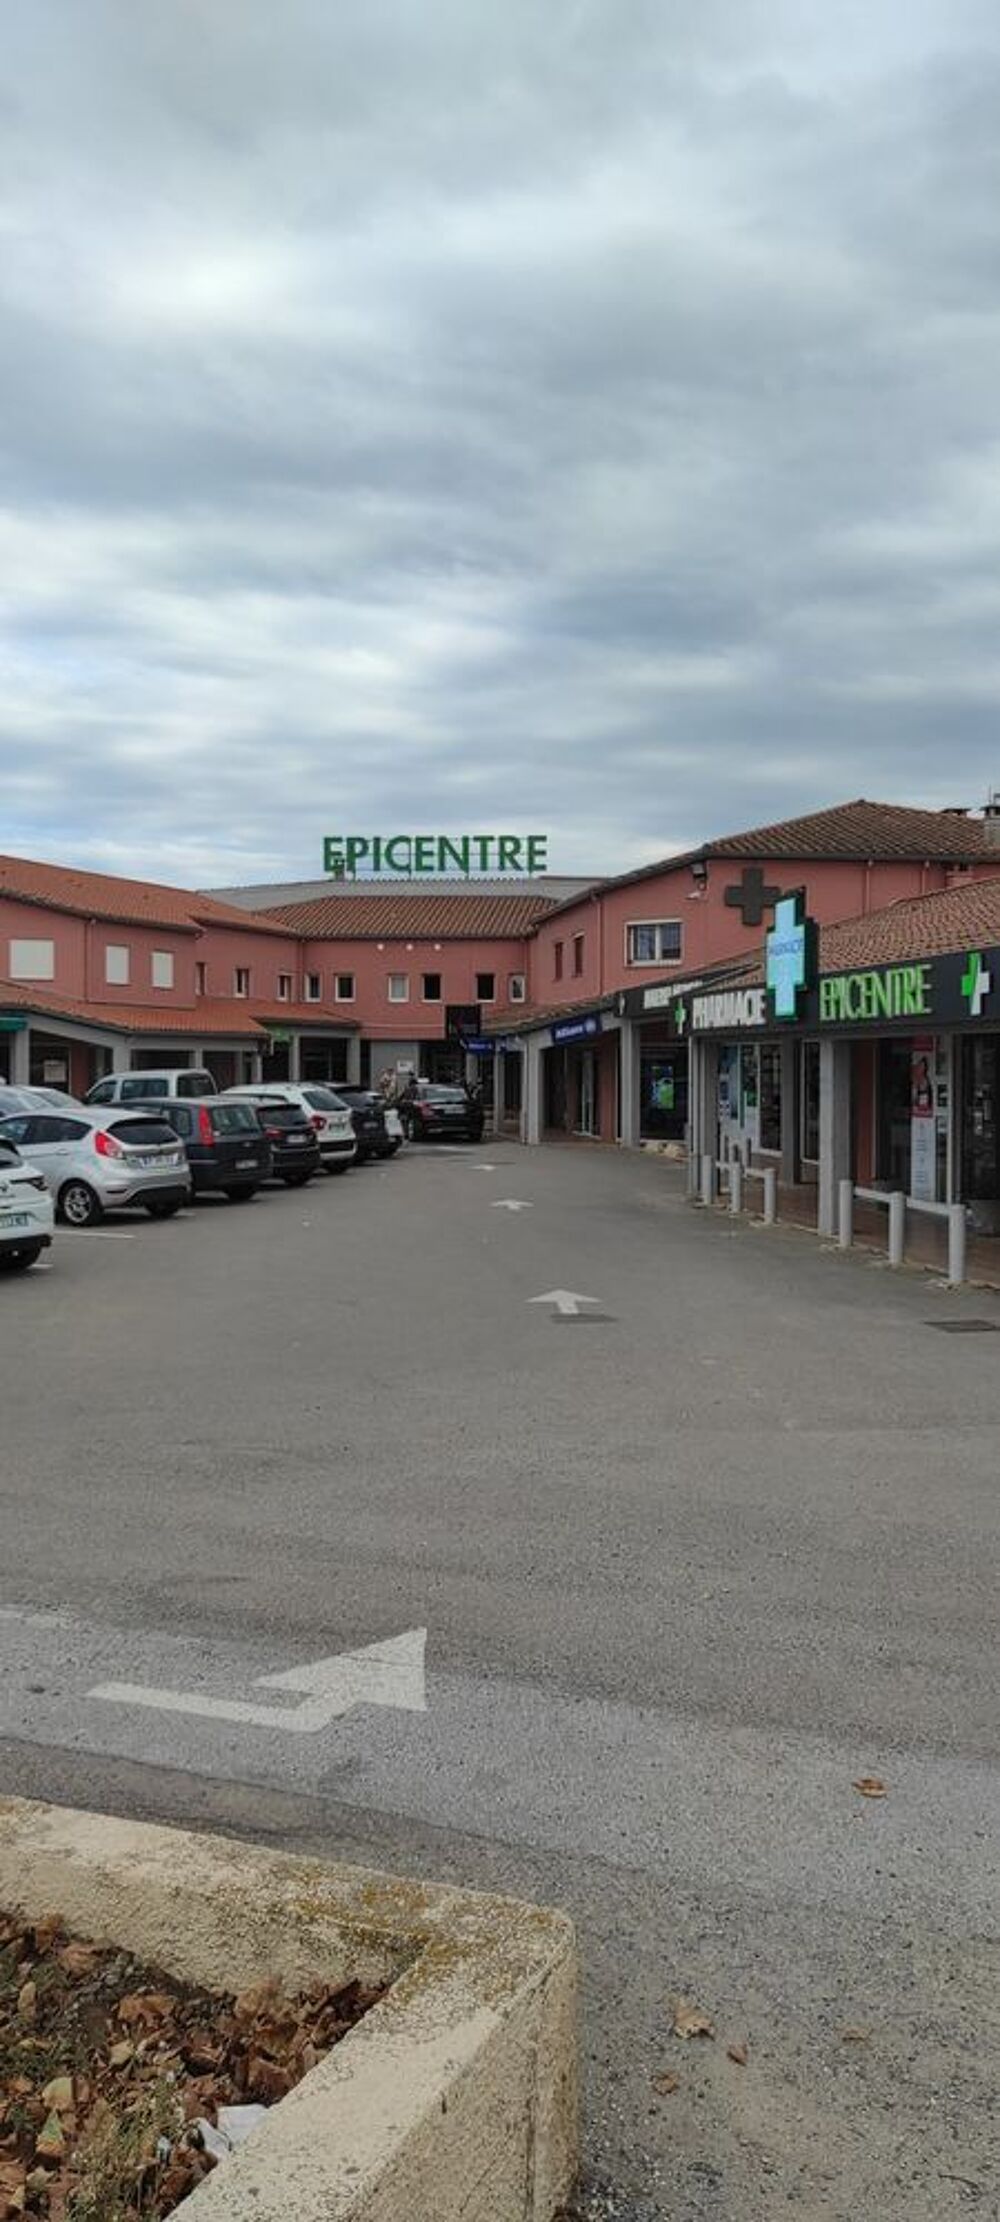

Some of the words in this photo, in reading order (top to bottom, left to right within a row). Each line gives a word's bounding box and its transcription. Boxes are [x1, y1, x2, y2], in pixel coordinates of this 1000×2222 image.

[323, 835, 548, 872] EPICENTRE
[693, 988, 766, 1030] PHARMACIE
[819, 964, 932, 1021] EPICENTRE
